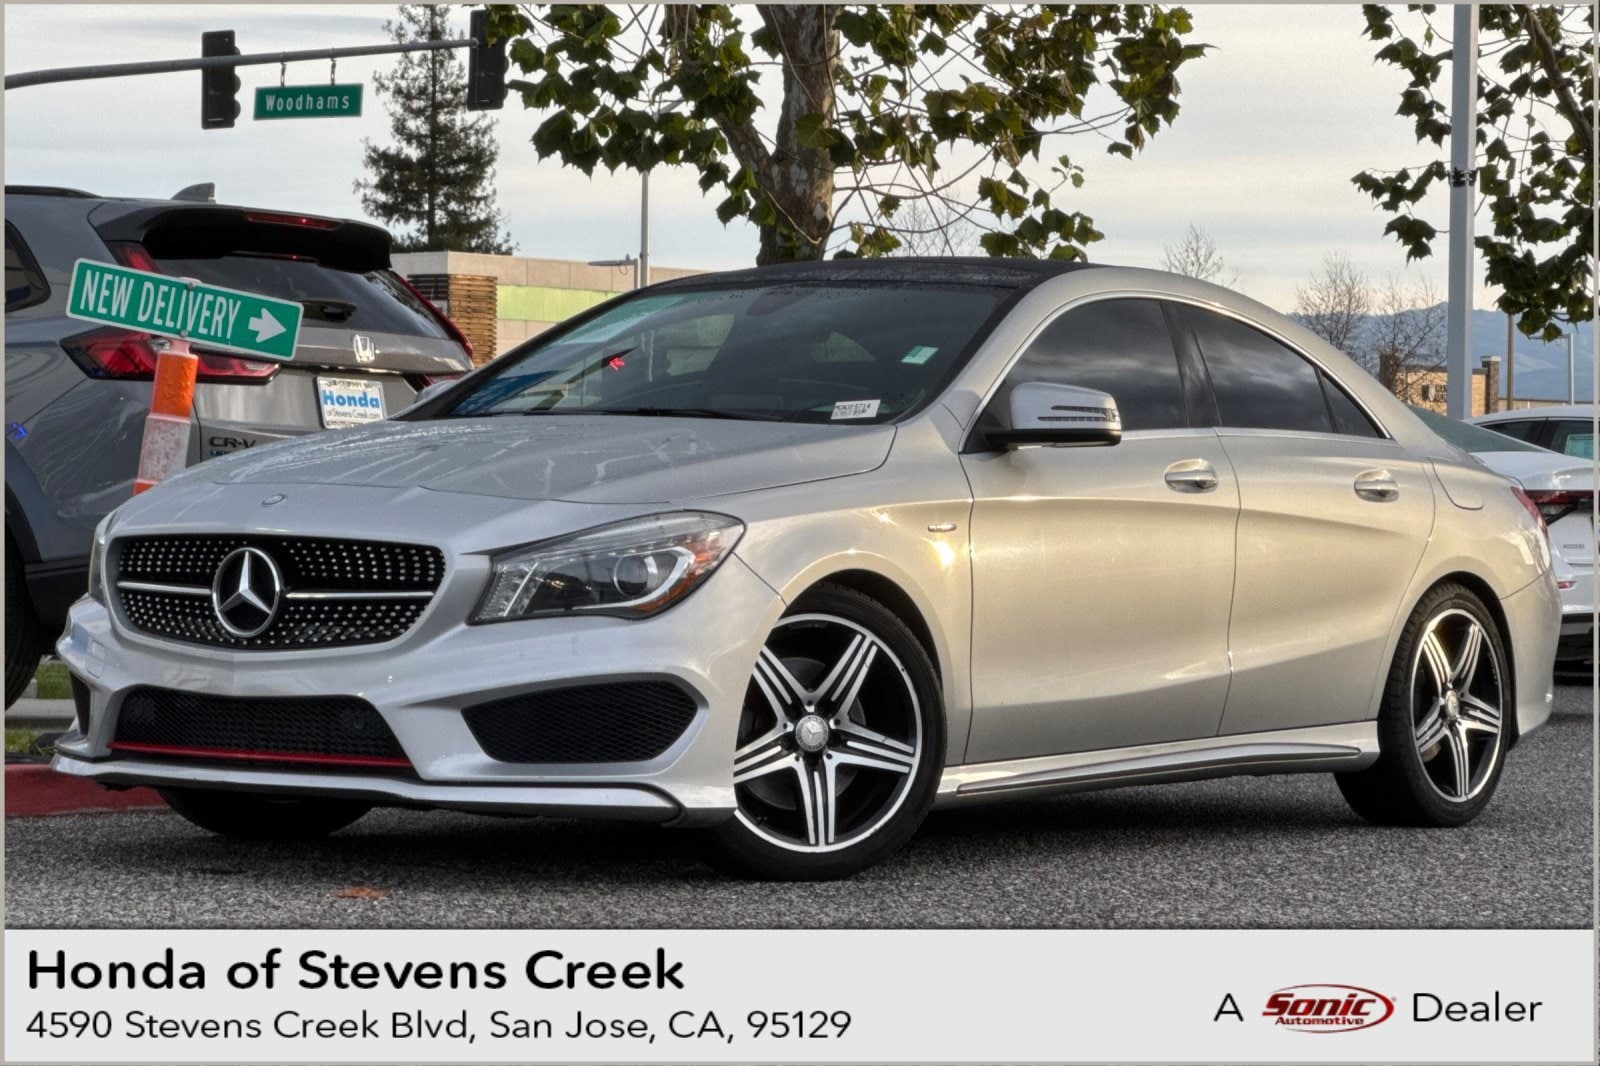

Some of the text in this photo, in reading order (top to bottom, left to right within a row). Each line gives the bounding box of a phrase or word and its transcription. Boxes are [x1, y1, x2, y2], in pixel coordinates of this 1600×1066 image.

[265, 93, 350, 112] Woodhams
[80, 269, 241, 339] NEW DELIVERY
[322, 390, 379, 408] Honda
[209, 436, 256, 449] CR-V
